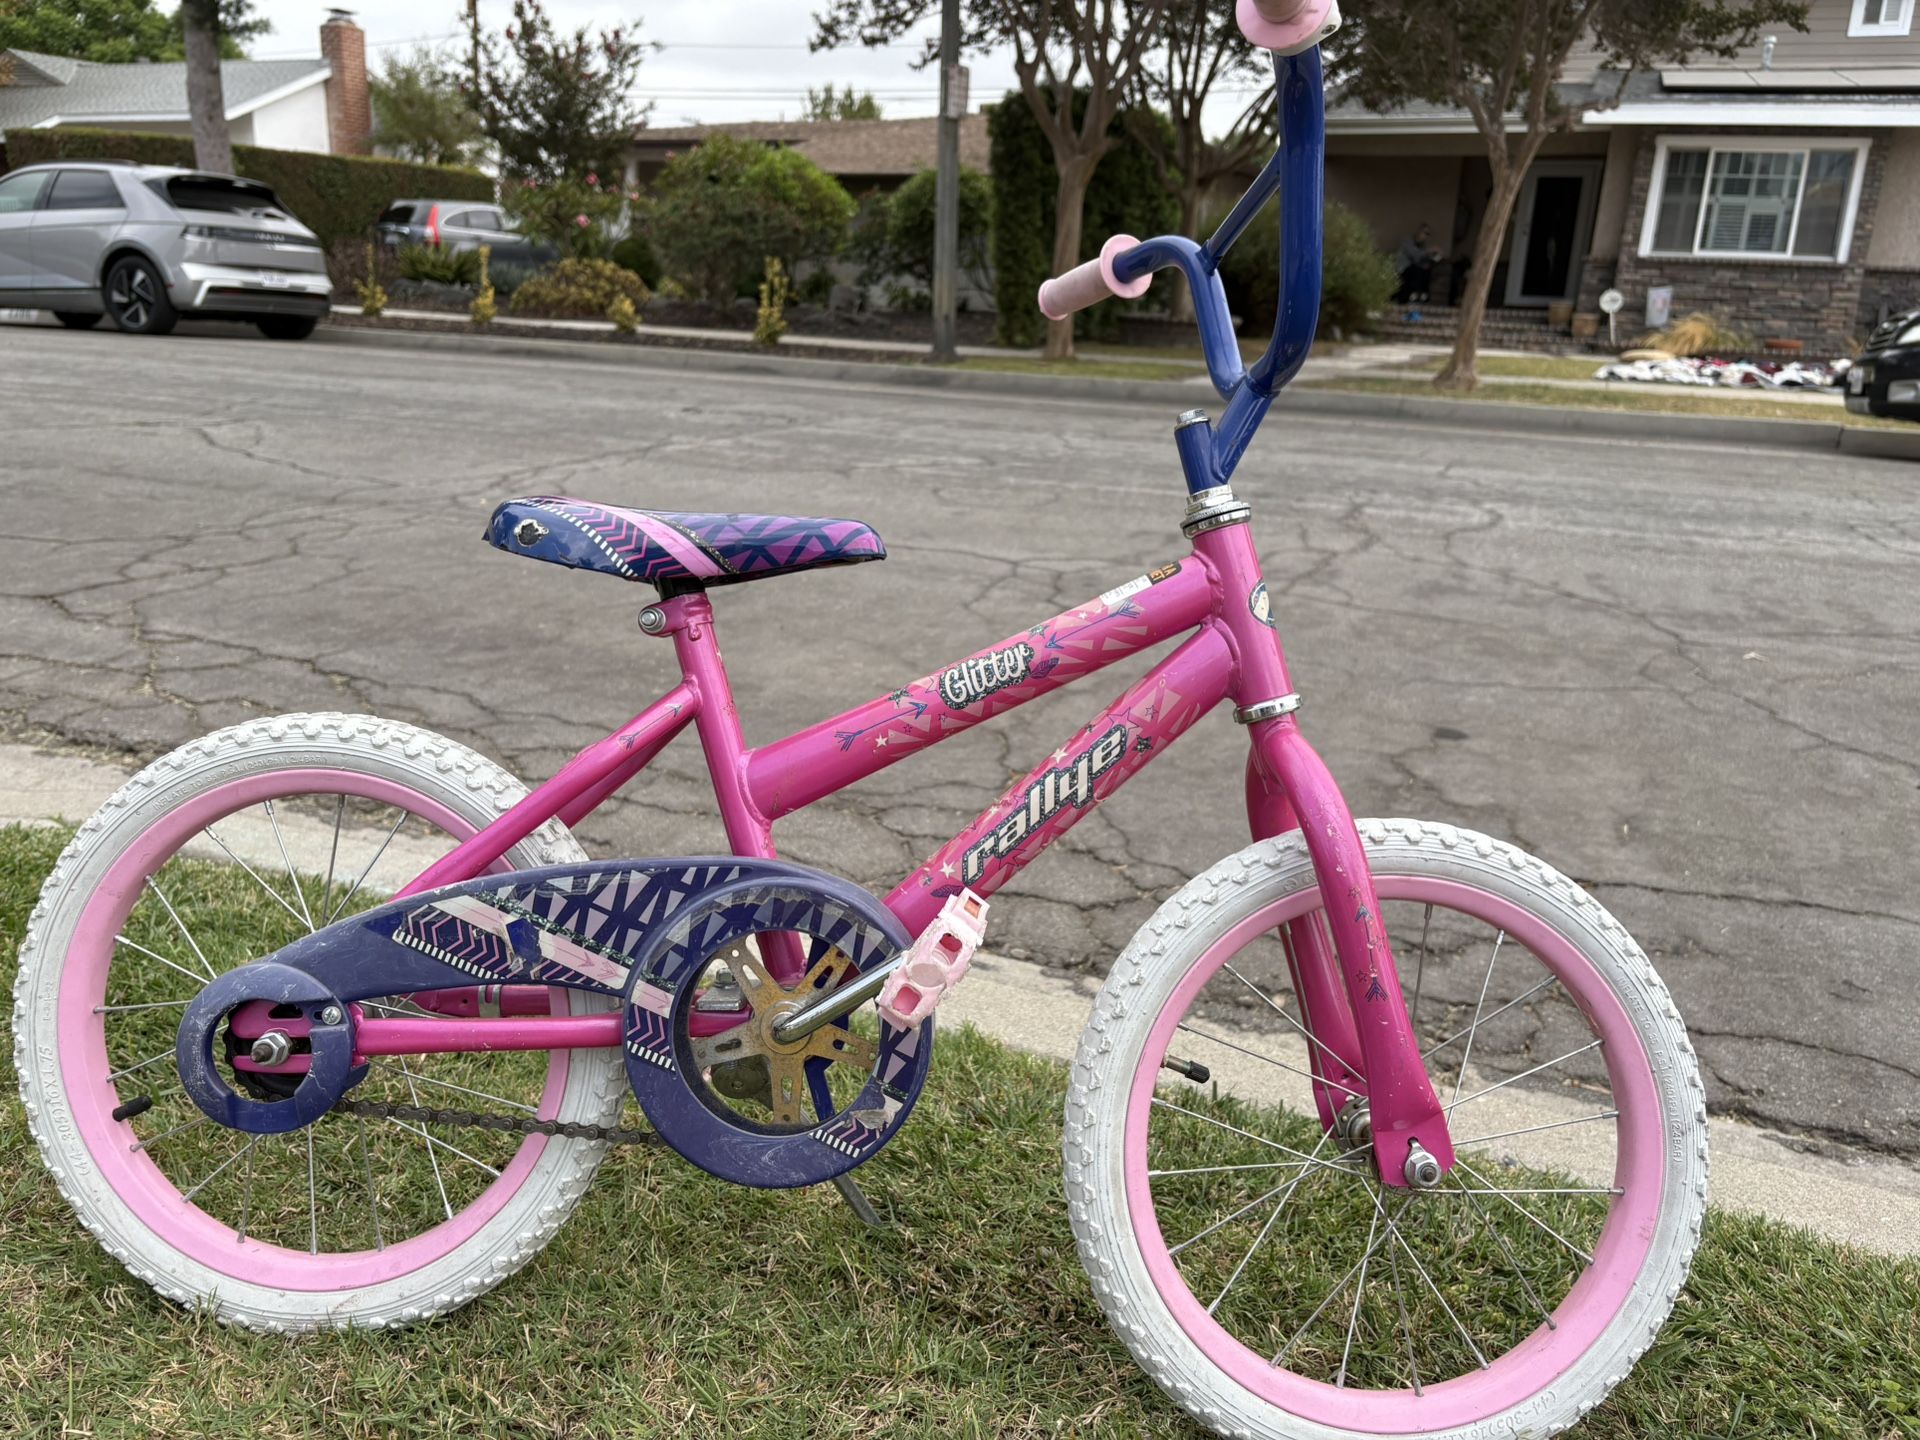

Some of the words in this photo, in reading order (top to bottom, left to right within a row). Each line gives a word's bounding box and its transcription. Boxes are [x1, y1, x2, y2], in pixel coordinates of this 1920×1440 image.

[944, 644, 1030, 703] Glitter
[152, 786, 188, 810] INFLATE
[190, 778, 204, 789] TO
[966, 729, 1122, 880] rallye
[1616, 976, 1644, 1015] INFLATE
[1641, 1015, 1652, 1030] TO
